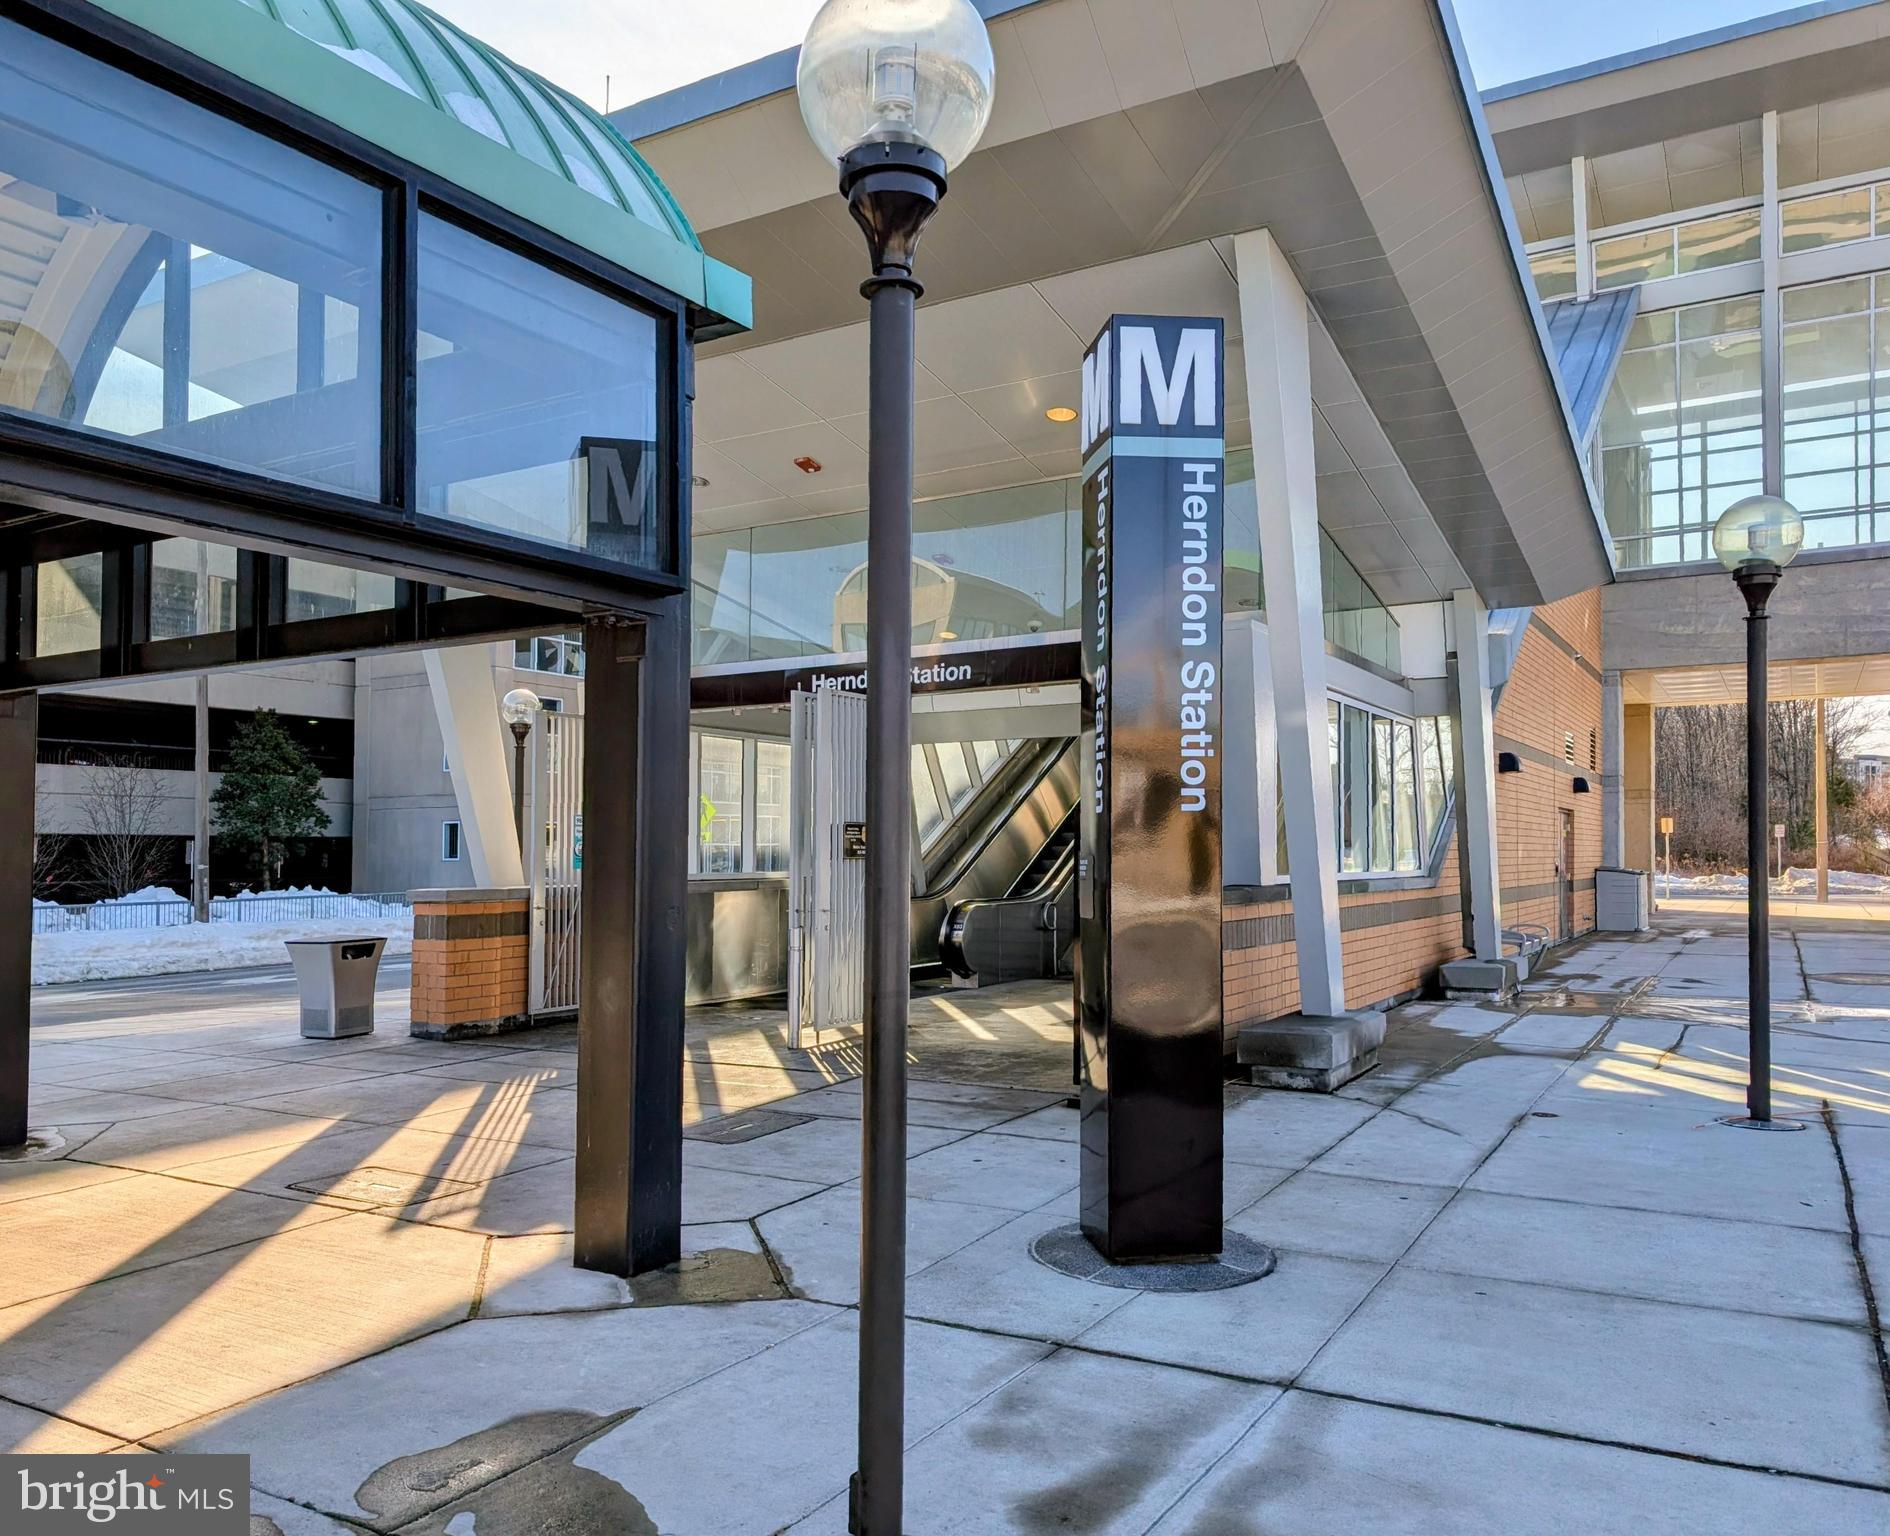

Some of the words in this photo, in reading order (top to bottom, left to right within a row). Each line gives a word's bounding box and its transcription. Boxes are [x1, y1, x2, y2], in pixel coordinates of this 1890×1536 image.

[1081, 330, 1109, 454] M
[1120, 326, 1215, 425] M
[589, 446, 656, 527] M
[1182, 463, 1216, 646] Herndon
[1096, 466, 1109, 651] Herndon
[811, 670, 868, 693] Hernd
[910, 663, 972, 684] tation
[1095, 665, 1106, 813] Station
[1181, 661, 1215, 812] Station
